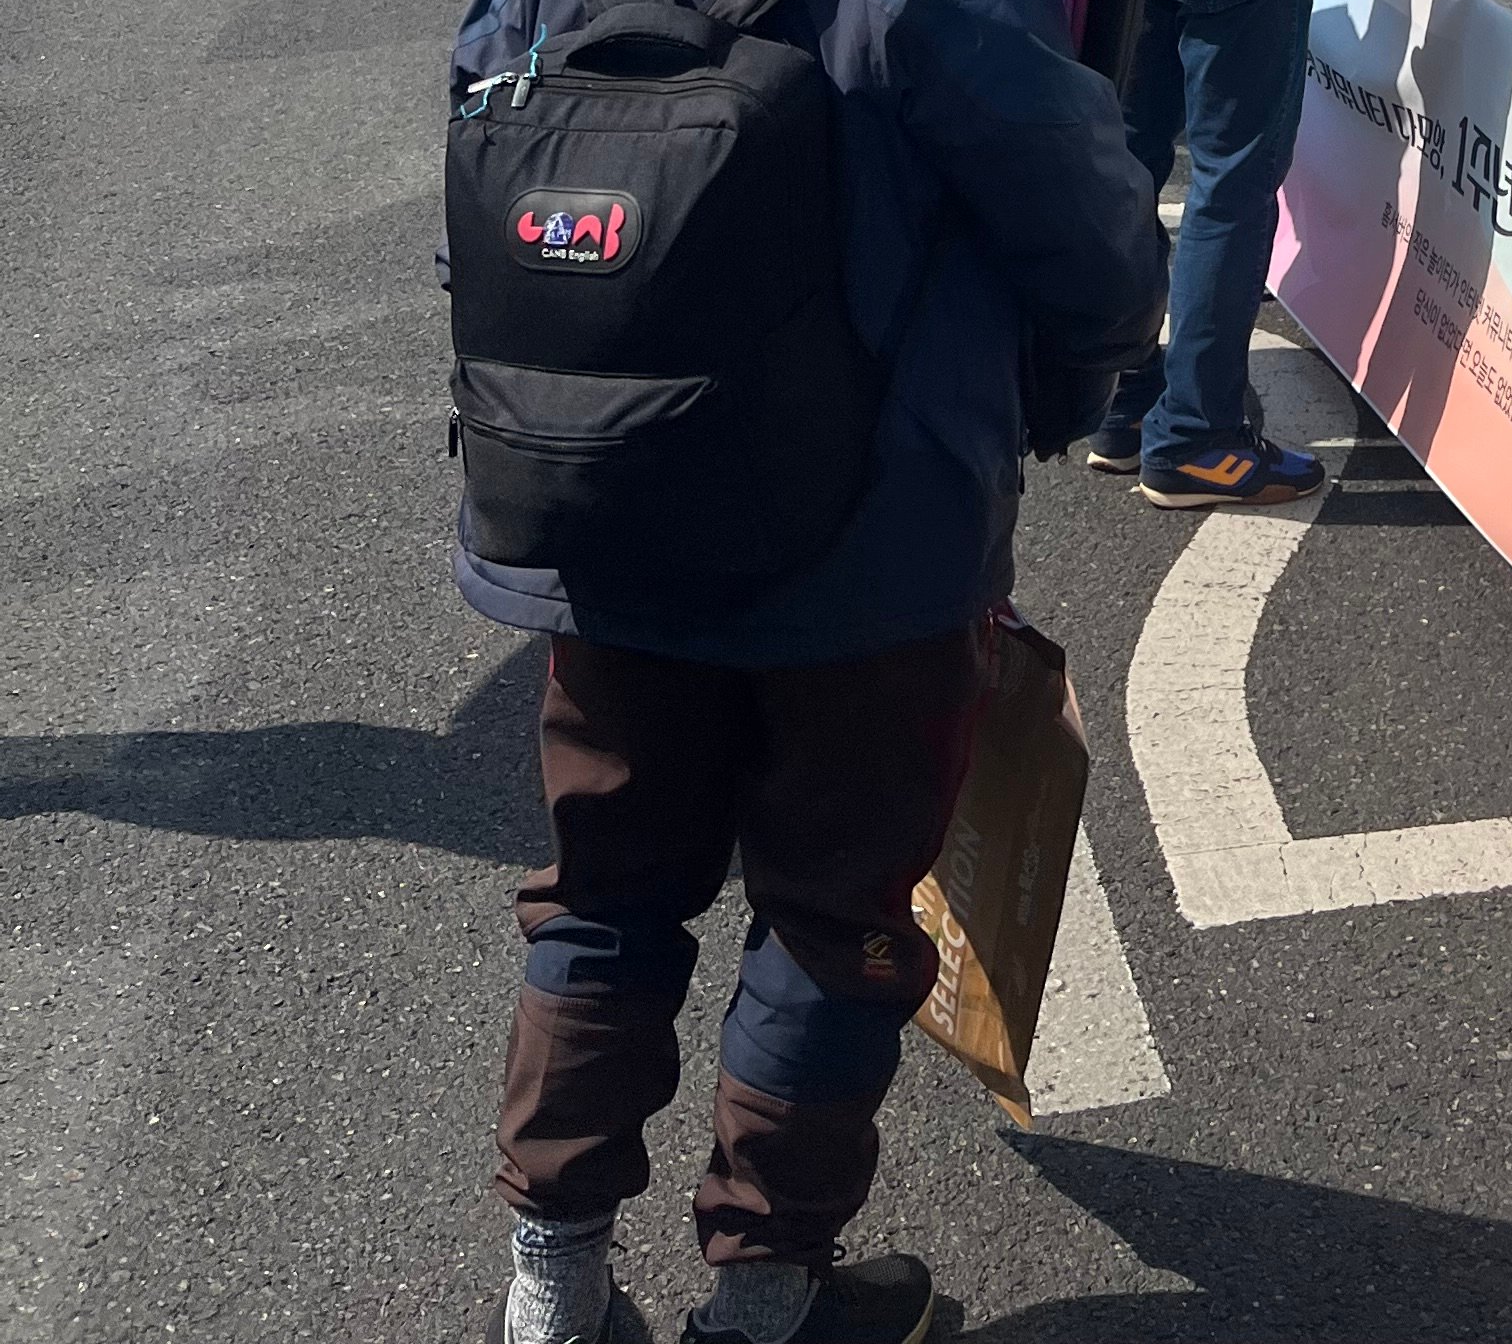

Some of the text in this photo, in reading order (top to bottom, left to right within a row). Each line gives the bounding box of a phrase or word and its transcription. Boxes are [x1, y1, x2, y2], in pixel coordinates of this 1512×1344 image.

[568, 248, 600, 263] English
[1413, 229, 1431, 265] 작은
[1426, 245, 1461, 297] 놀이터가
[1413, 288, 1442, 338] 당신이
[1468, 350, 1498, 395] 오늘도
